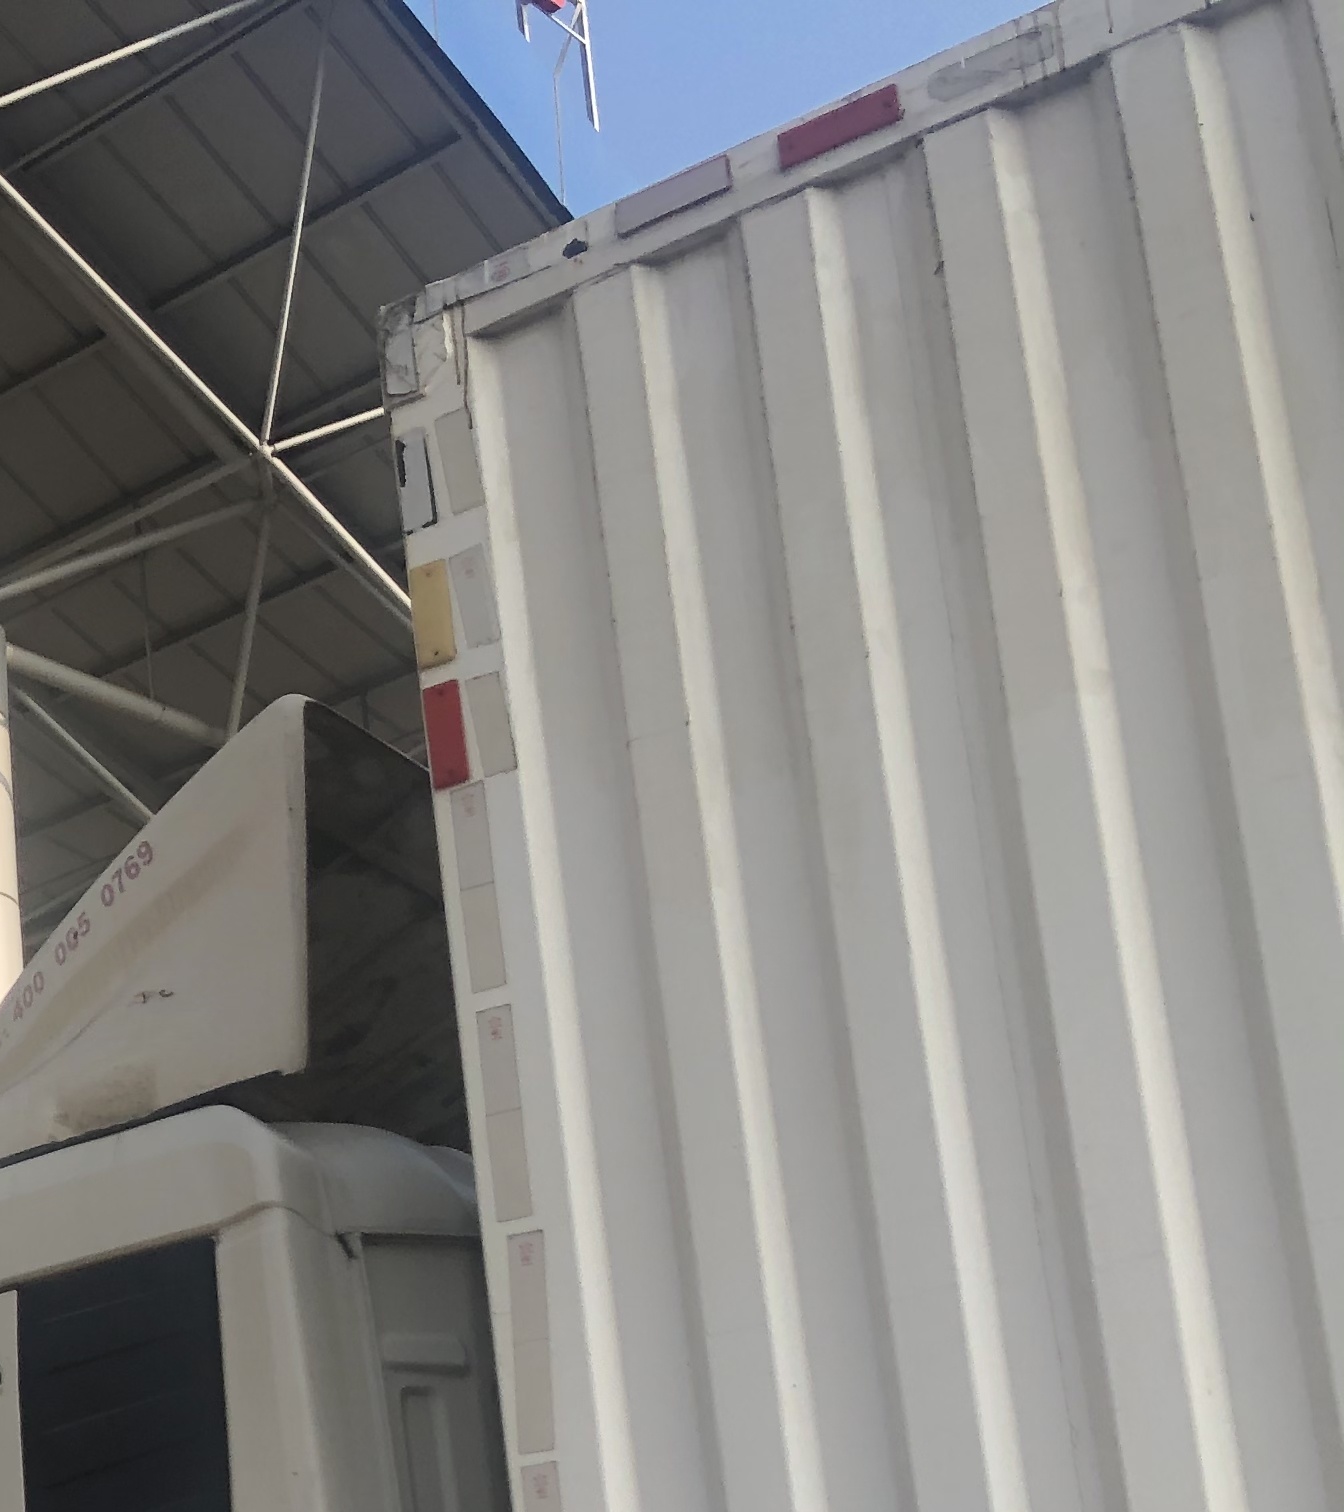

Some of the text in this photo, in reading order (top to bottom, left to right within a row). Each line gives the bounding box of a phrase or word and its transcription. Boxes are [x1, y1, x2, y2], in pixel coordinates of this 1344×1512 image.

[12, 840, 153, 1021] 400 005 0769
